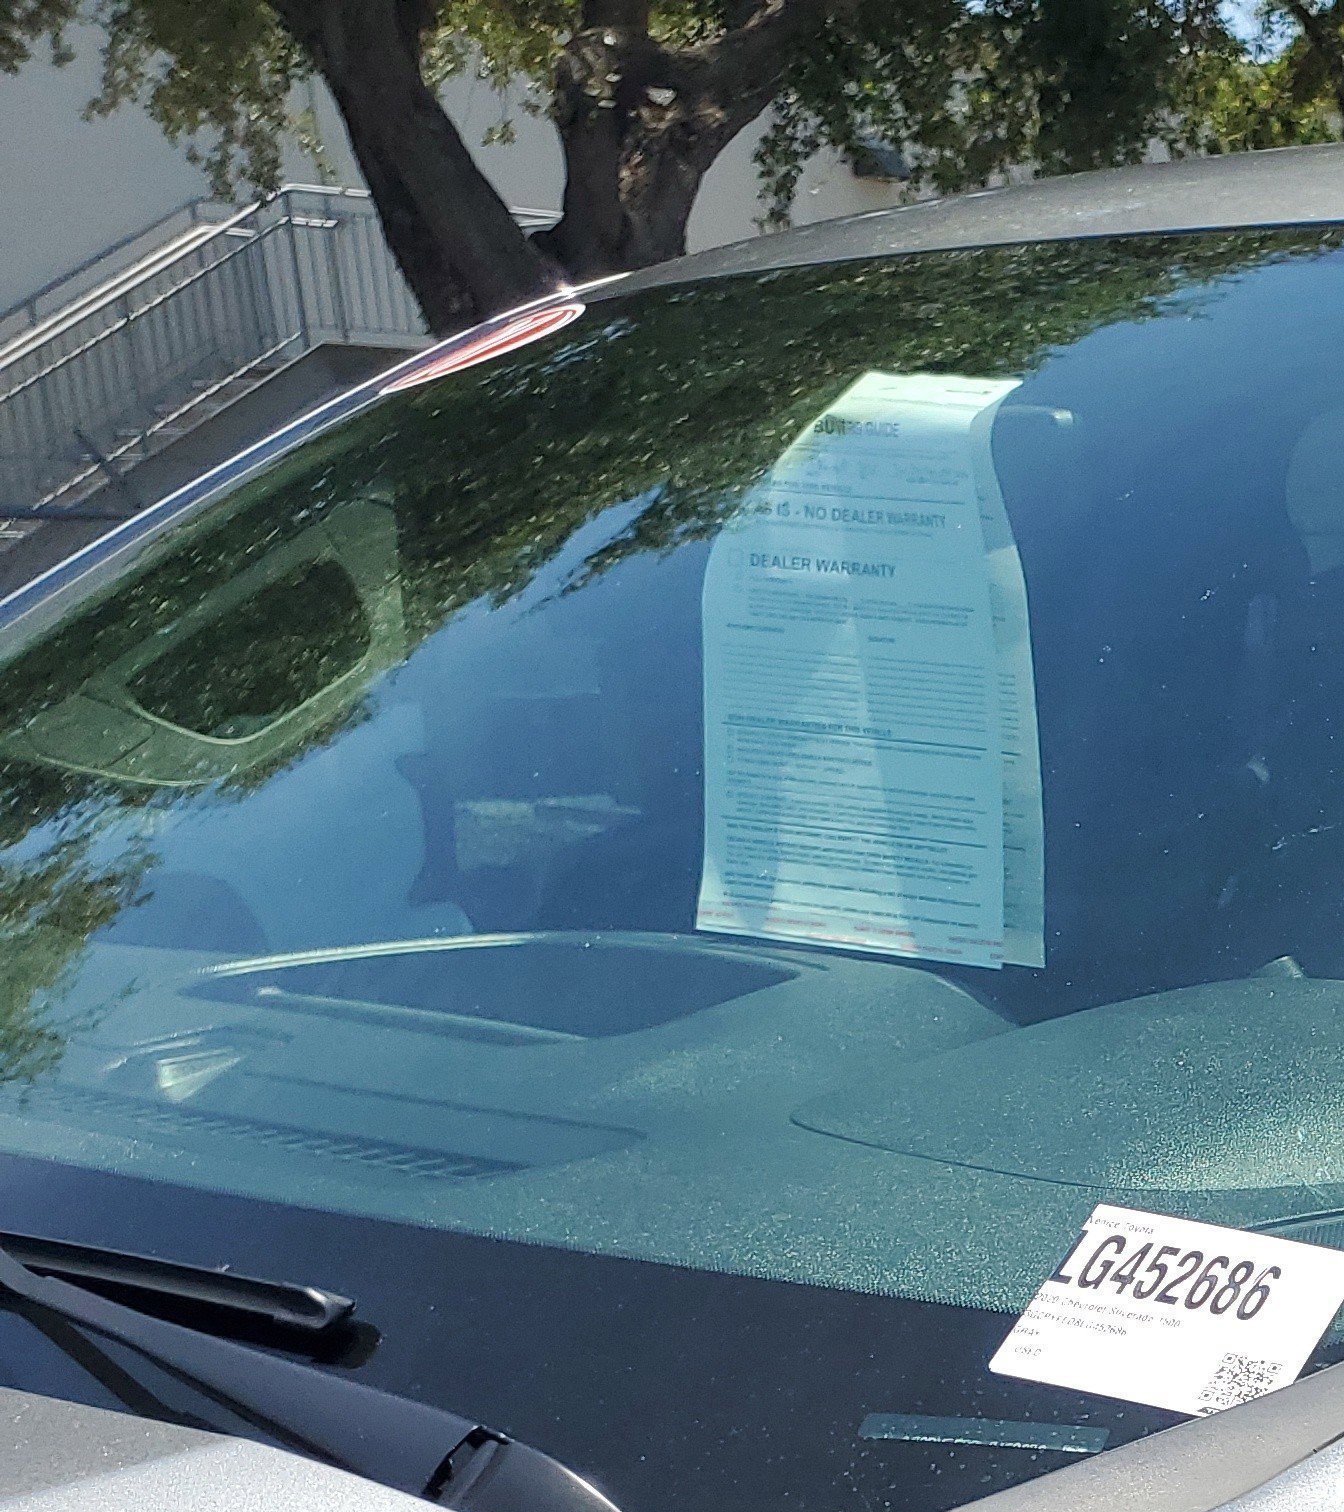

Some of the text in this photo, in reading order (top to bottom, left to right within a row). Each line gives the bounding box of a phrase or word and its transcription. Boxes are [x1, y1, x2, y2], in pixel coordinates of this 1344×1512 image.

[803, 504, 827, 521] NO
[831, 507, 883, 524] DEALER
[750, 553, 896, 578] DEALER WARRANTY
[1050, 1229, 1282, 1320] LG452686
